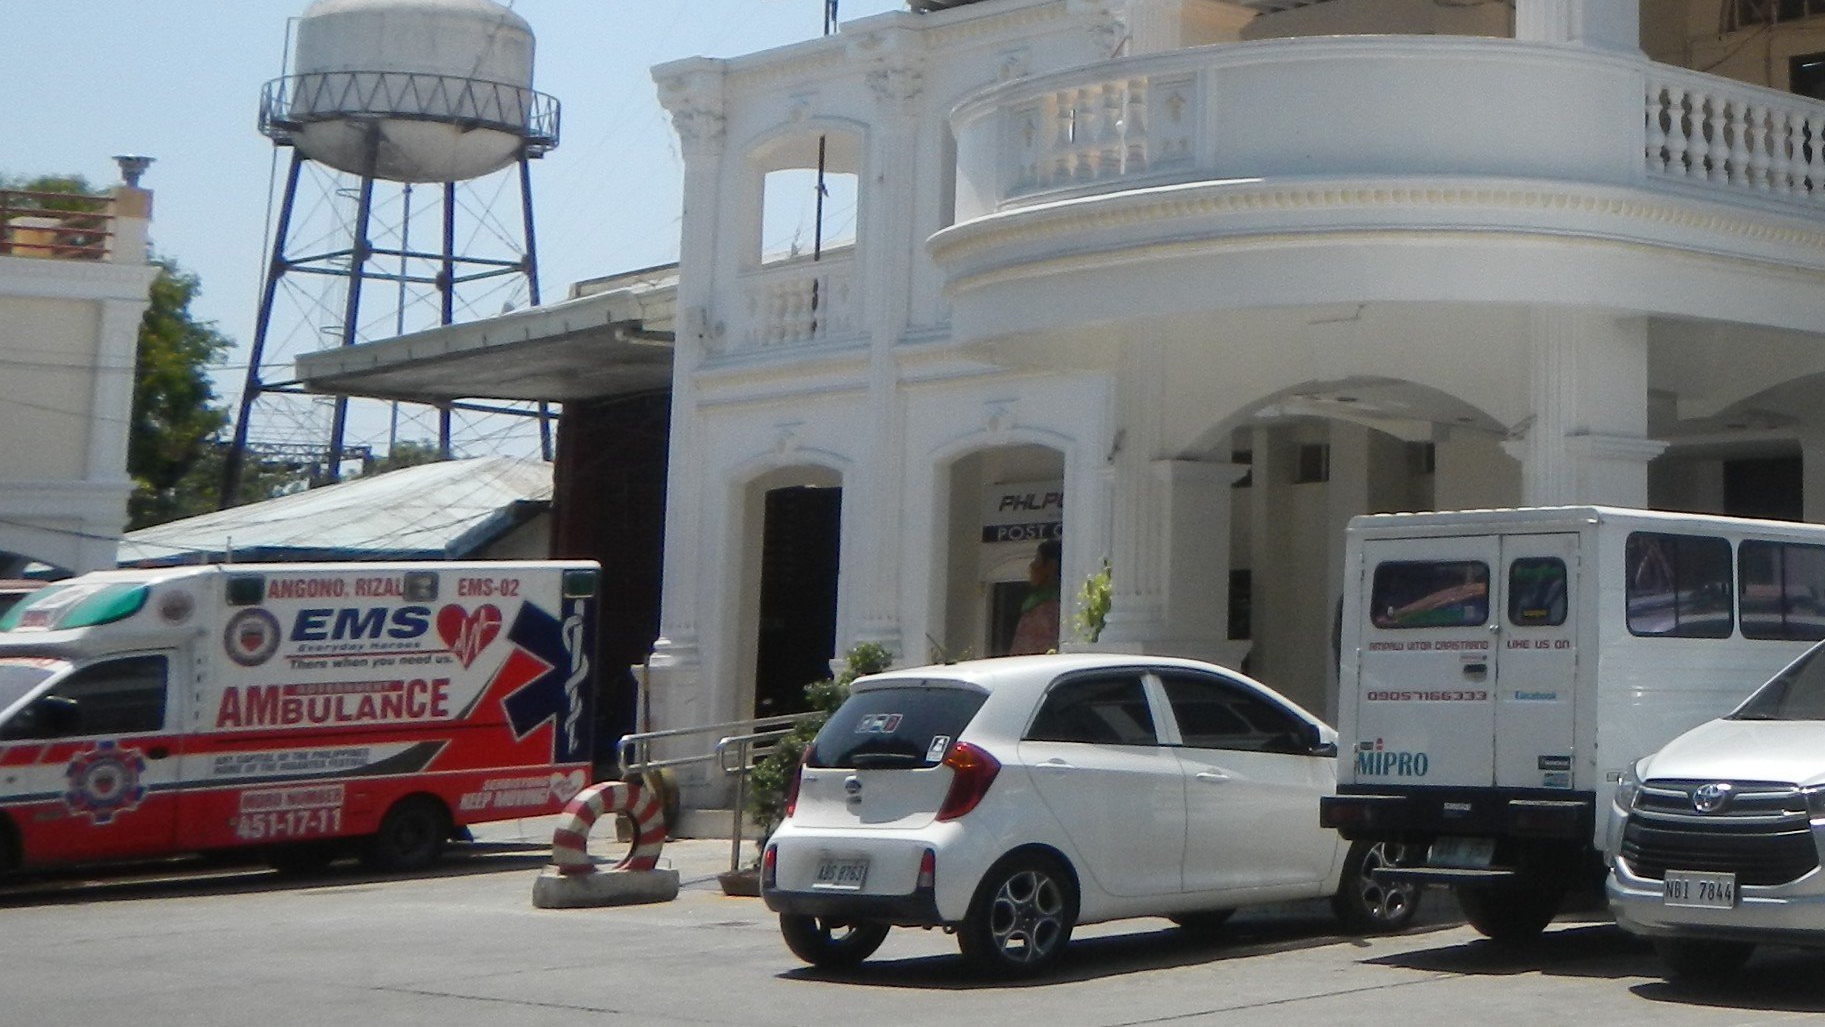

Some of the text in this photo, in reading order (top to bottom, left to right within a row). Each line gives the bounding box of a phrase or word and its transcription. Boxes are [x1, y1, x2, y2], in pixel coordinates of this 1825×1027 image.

[998, 492, 1062, 512] PHLP
[998, 524, 1046, 541] POST
[355, 578, 403, 597] RIZAL
[457, 578, 520, 597] EMS-02
[290, 605, 431, 641] EMS
[1507, 639, 1570, 649] LIKE US ON
[290, 659, 328, 669] There
[333, 658, 368, 668] when
[372, 658, 395, 669] you
[399, 654, 431, 665] need
[215, 677, 450, 727] AMBULANCE
[1666, 879, 1732, 901] NBI 7844
